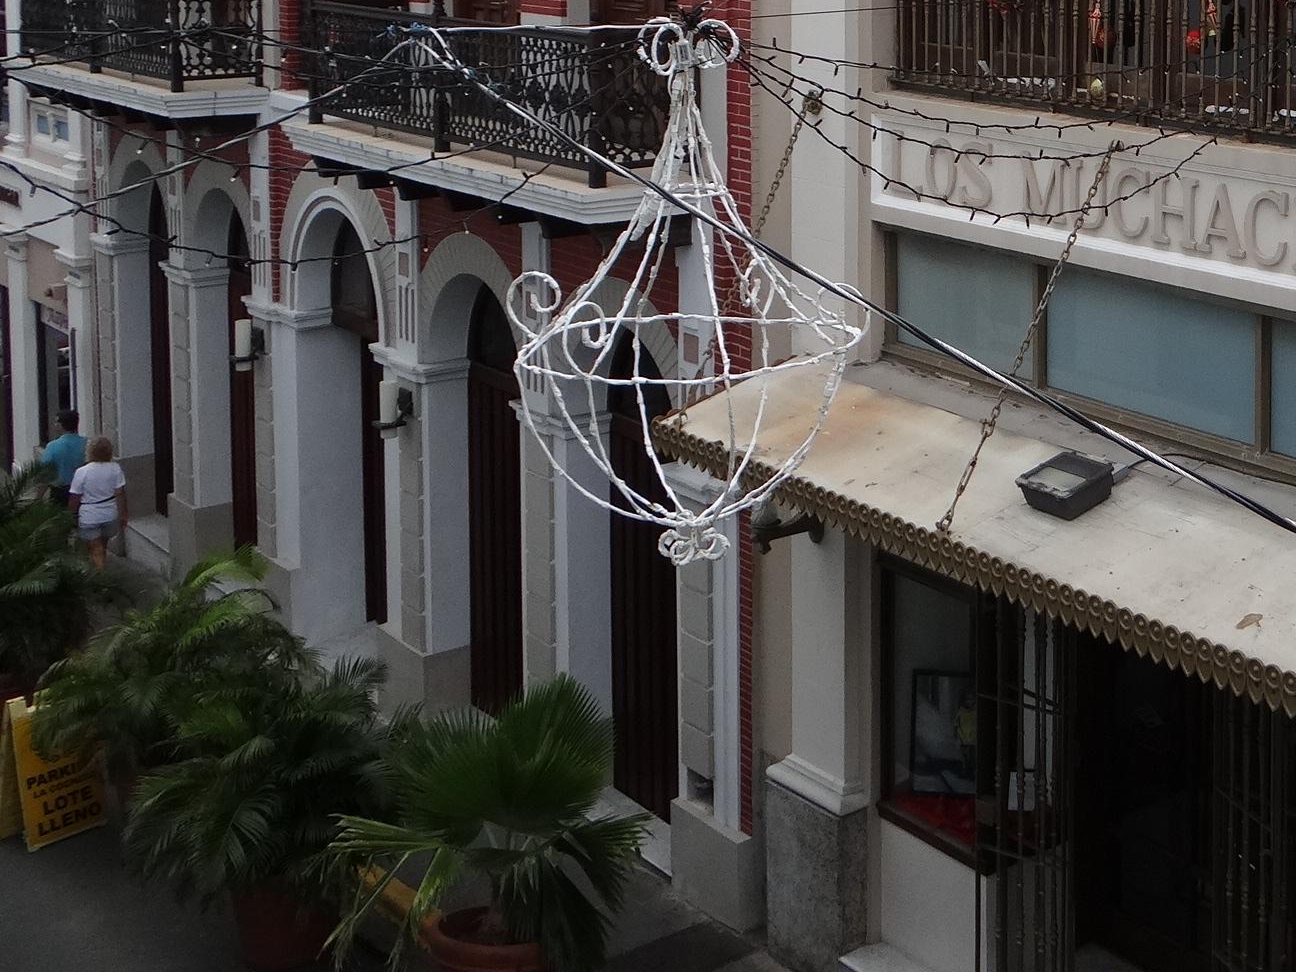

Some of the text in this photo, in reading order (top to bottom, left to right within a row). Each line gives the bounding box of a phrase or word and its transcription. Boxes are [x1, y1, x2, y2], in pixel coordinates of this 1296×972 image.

[889, 129, 993, 210] LOS
[27, 762, 79, 790] PARKI
[43, 785, 94, 816] LOTE
[38, 801, 102, 837] LLENO
